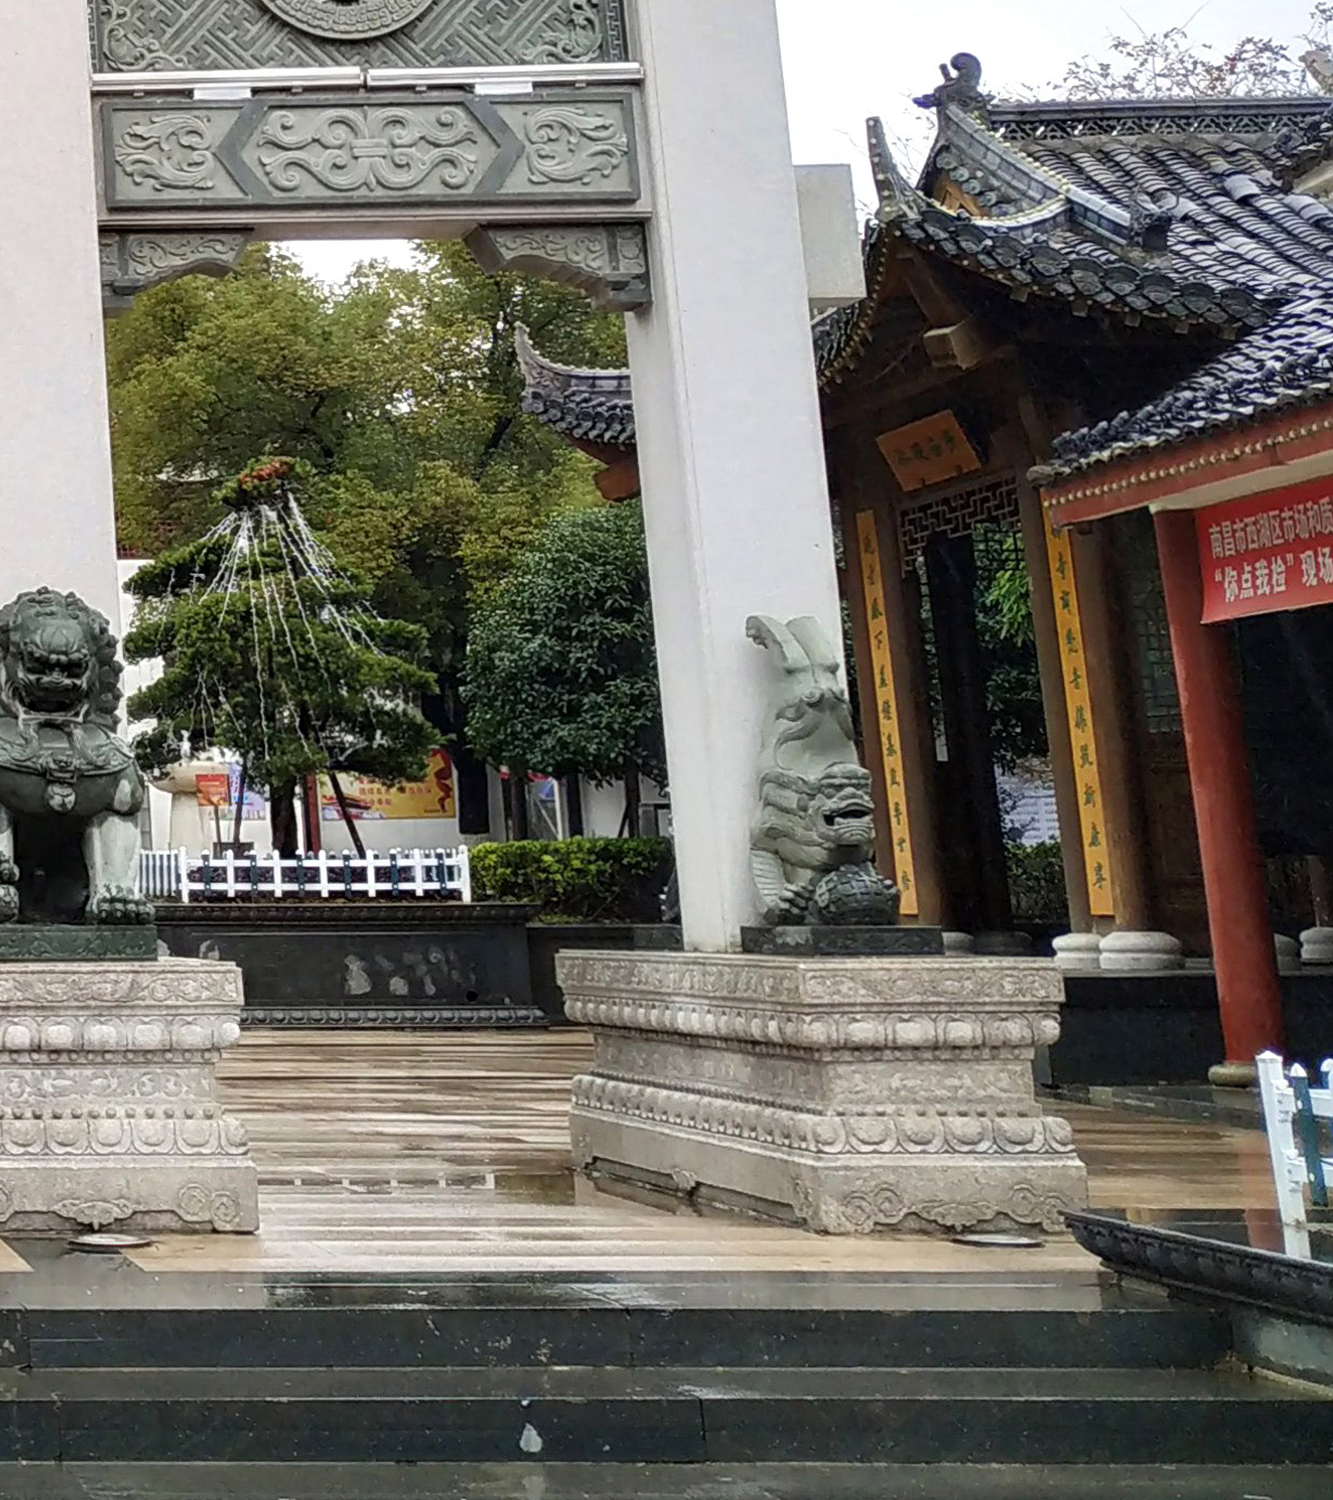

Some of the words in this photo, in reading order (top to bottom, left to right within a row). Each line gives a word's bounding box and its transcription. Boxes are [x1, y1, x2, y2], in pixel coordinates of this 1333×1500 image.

[1208, 496, 1333, 559] 南昌市西湖区市场和质
